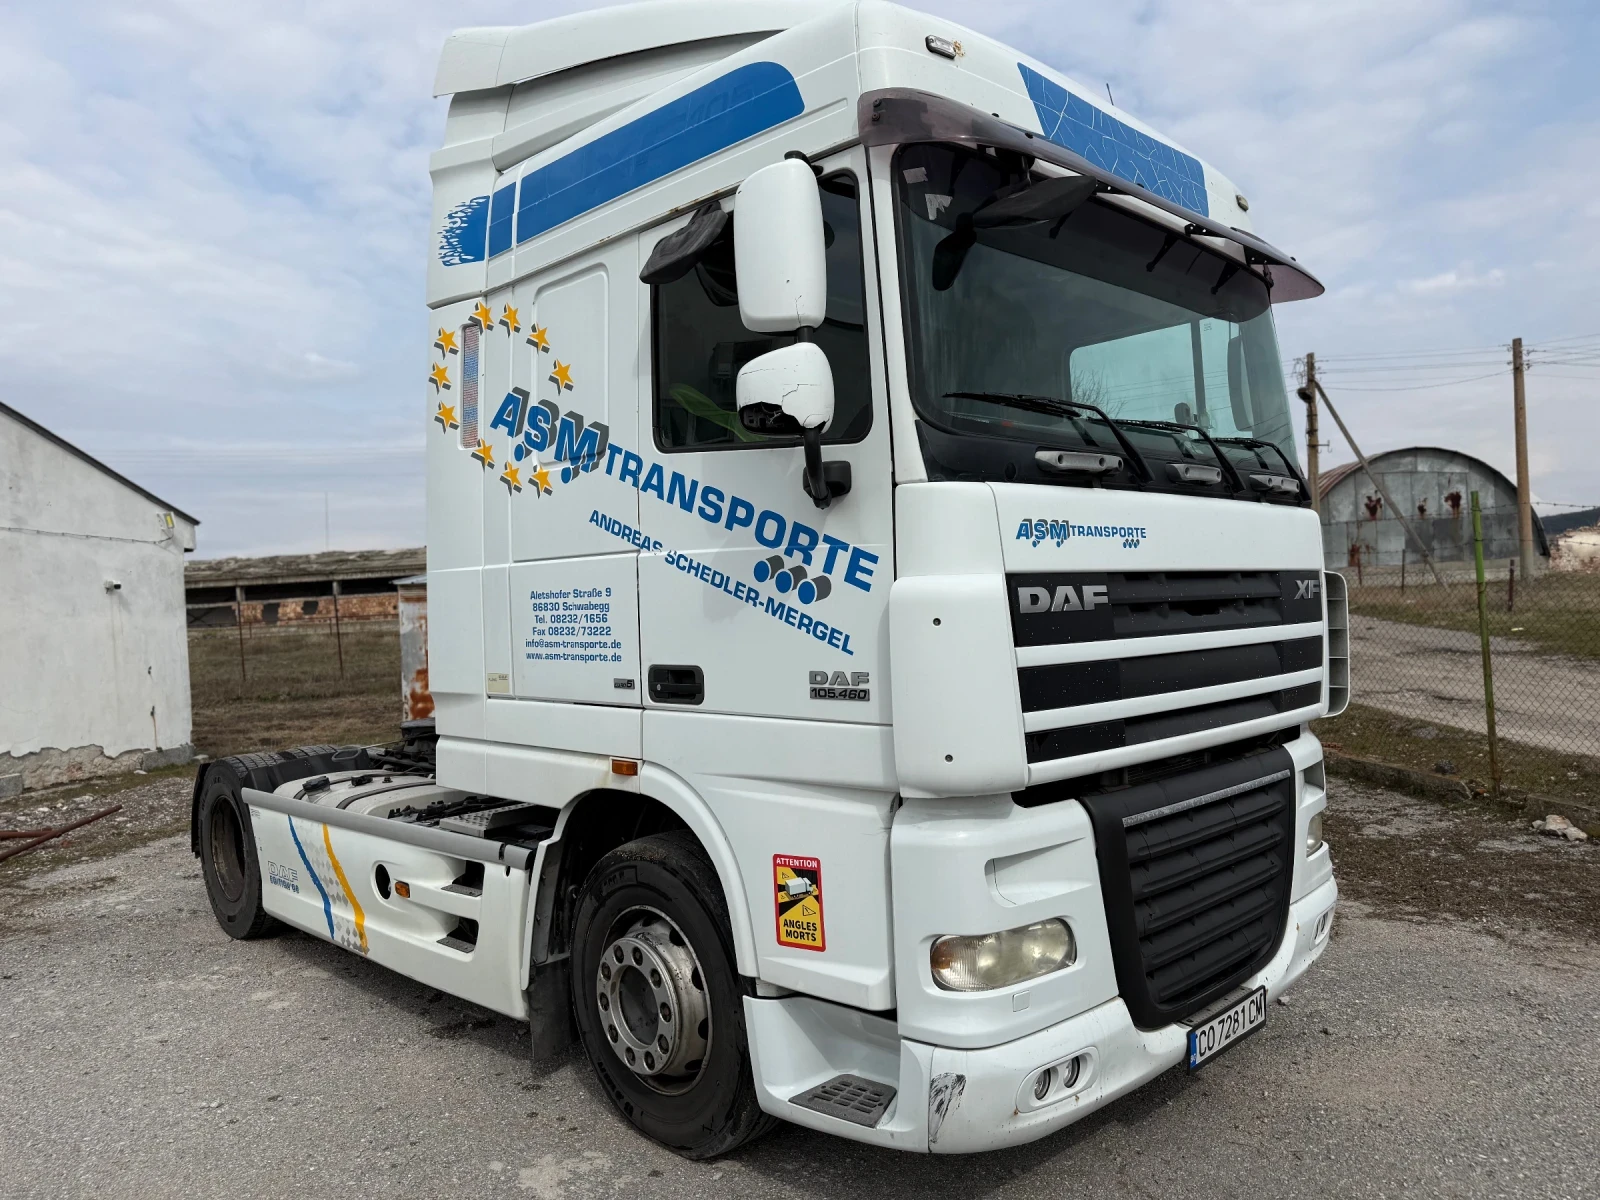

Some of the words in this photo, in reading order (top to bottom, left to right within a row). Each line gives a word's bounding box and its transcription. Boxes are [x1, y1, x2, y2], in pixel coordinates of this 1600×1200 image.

[490, 386, 609, 473] ASM
[605, 442, 880, 593] TRANSPORTE
[1015, 518, 1070, 541] ASM
[1069, 524, 1147, 539] TRANSPORTE
[588, 509, 663, 555] ANDREAS
[664, 550, 855, 656] SCHEDLER-MERGEL
[1294, 579, 1320, 600] XF
[530, 590, 571, 600] Aletshofer
[572, 587, 603, 599] Straße
[605, 587, 612, 598] 9
[1017, 584, 1109, 614] DAF
[532, 602, 560, 612] 86830
[562, 601, 610, 613] Schwabegg
[534, 614, 548, 624] Tel.
[550, 613, 608, 625] 08232/1656
[532, 627, 546, 636] Fax
[548, 626, 612, 637] 08232/73222
[525, 638, 622, 651] info@asm-transporte.de
[526, 652, 622, 663] www.asm-transporte.de
[809, 670, 870, 687] DAF
[810, 687, 869, 700] 105.460
[776, 857, 818, 868] ATTENTION
[268, 860, 298, 882] DAF
[783, 918, 818, 932] ANGLES
[785, 928, 817, 942] MORTS
[1199, 1025, 1215, 1057] CO
[1217, 1005, 1246, 1047] 7281
[1248, 992, 1263, 1025] CM
